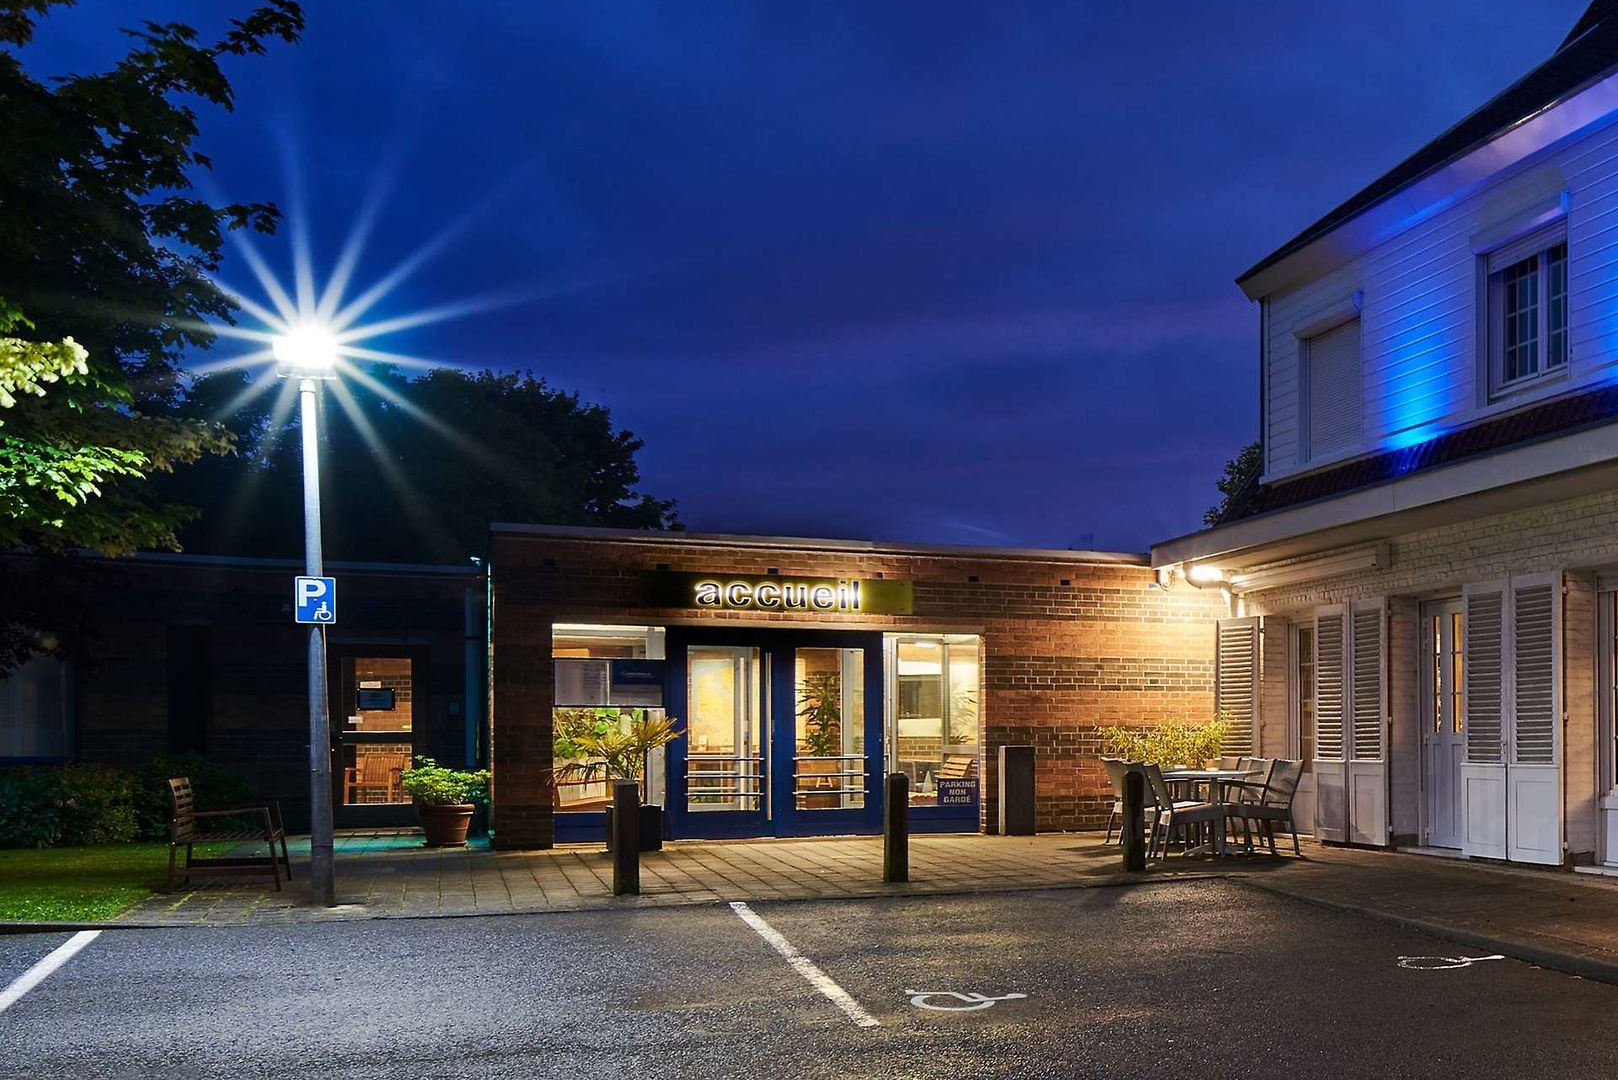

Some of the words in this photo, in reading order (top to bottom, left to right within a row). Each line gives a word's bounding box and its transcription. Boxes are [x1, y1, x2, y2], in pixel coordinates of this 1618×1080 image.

[298, 579, 326, 607] P
[695, 580, 861, 610] accueil
[949, 788, 967, 796] NON
